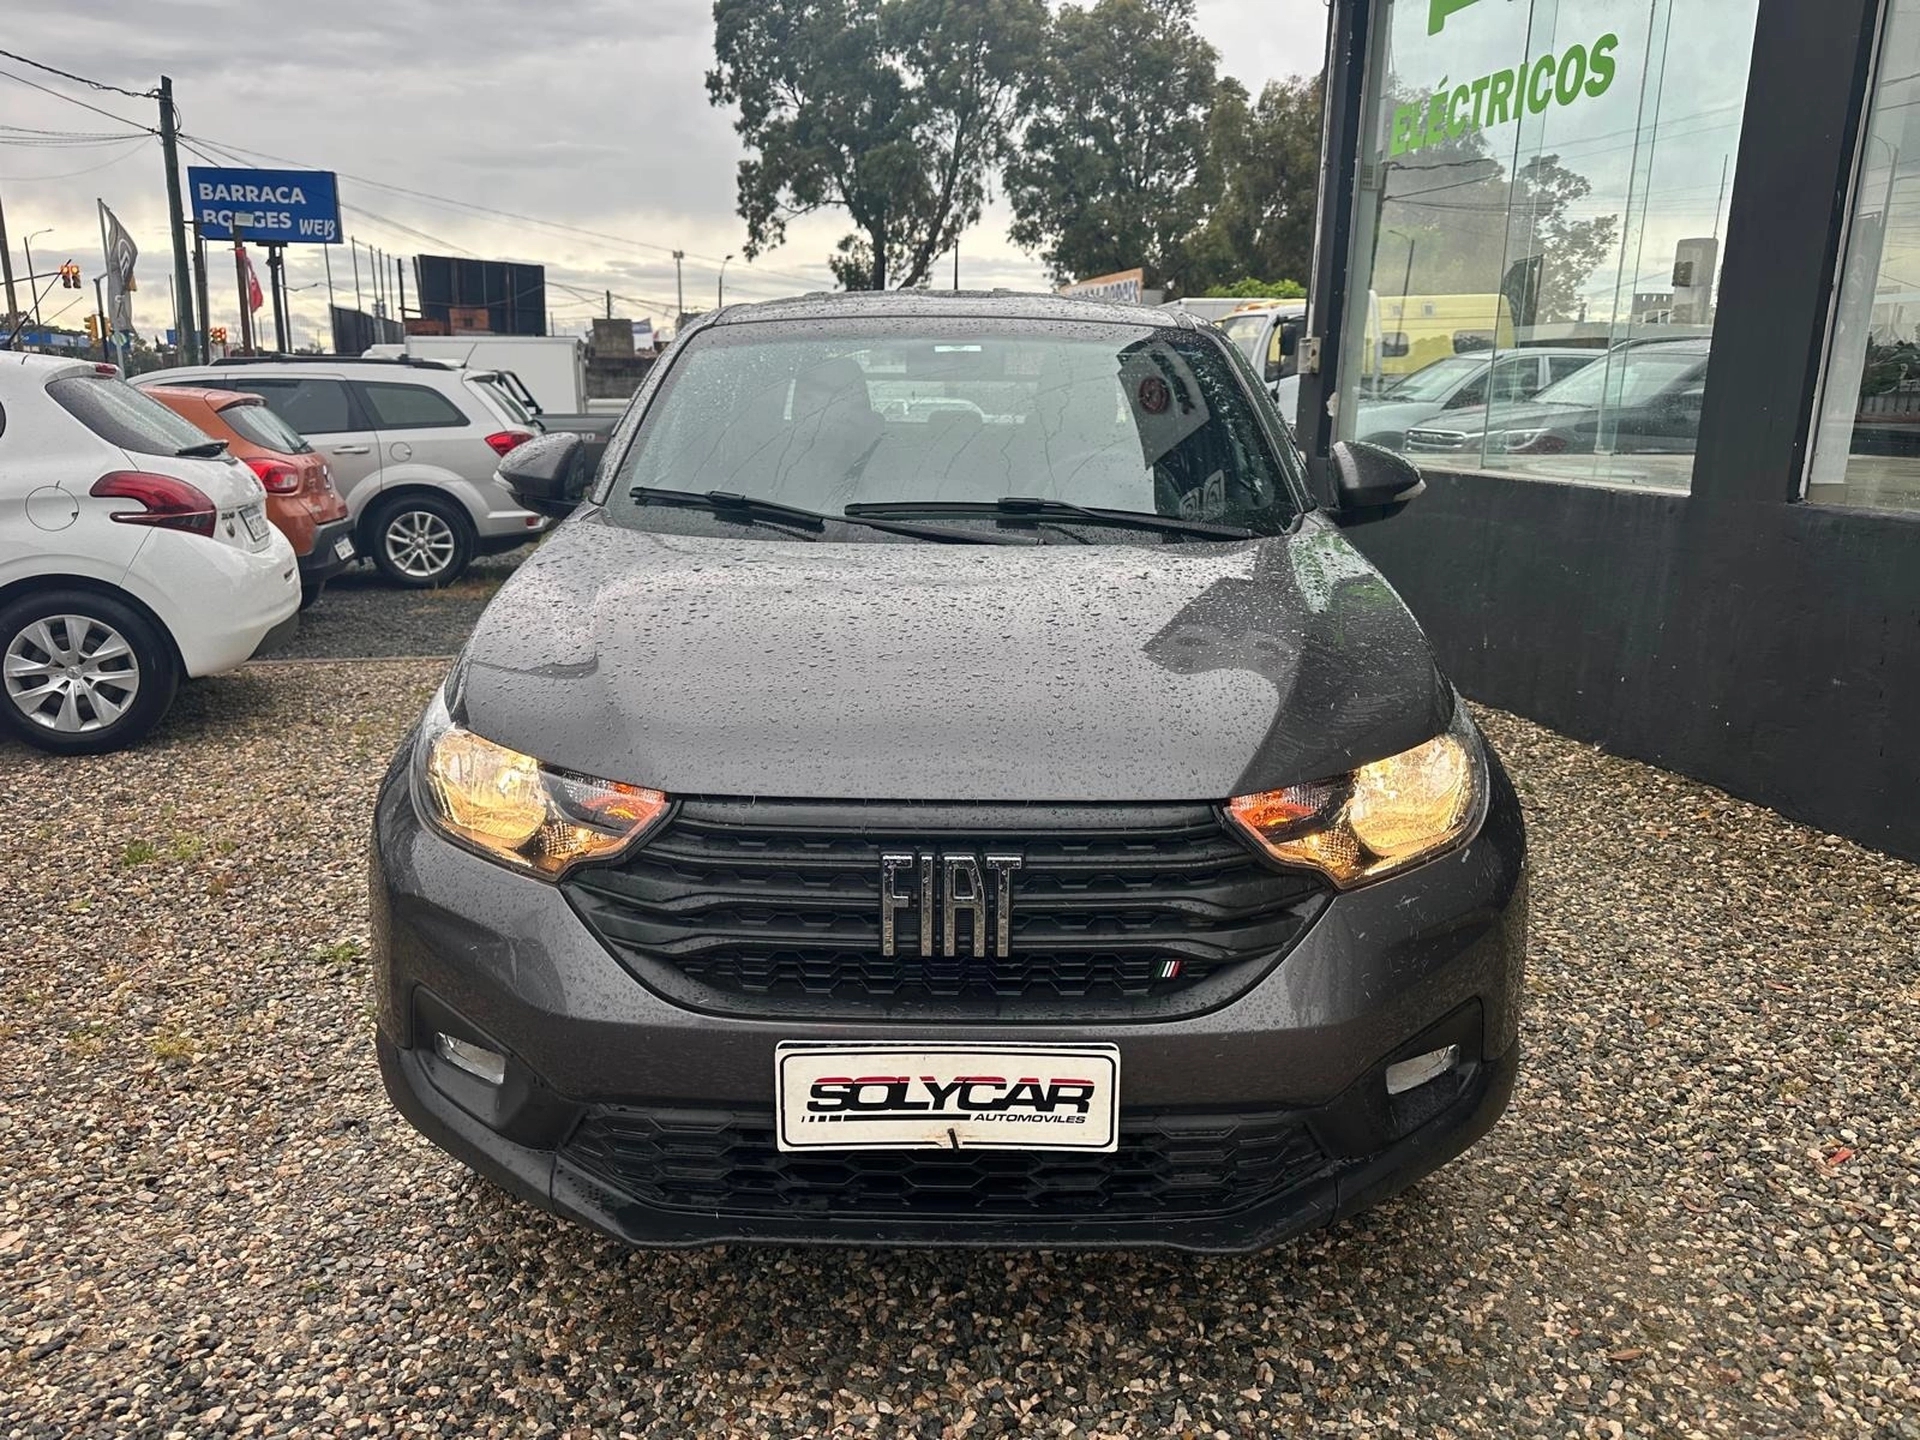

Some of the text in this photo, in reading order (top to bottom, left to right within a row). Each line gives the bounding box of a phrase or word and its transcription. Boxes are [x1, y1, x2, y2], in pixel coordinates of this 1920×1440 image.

[1389, 33, 1619, 157] ELÉCTRICOS
[198, 183, 307, 205] BARRACA
[202, 209, 292, 229] BOGES
[880, 853, 1023, 957] FIAT
[807, 1076, 1095, 1113] SOLYCAR
[974, 1113, 1086, 1124] AUTOMOVILES
